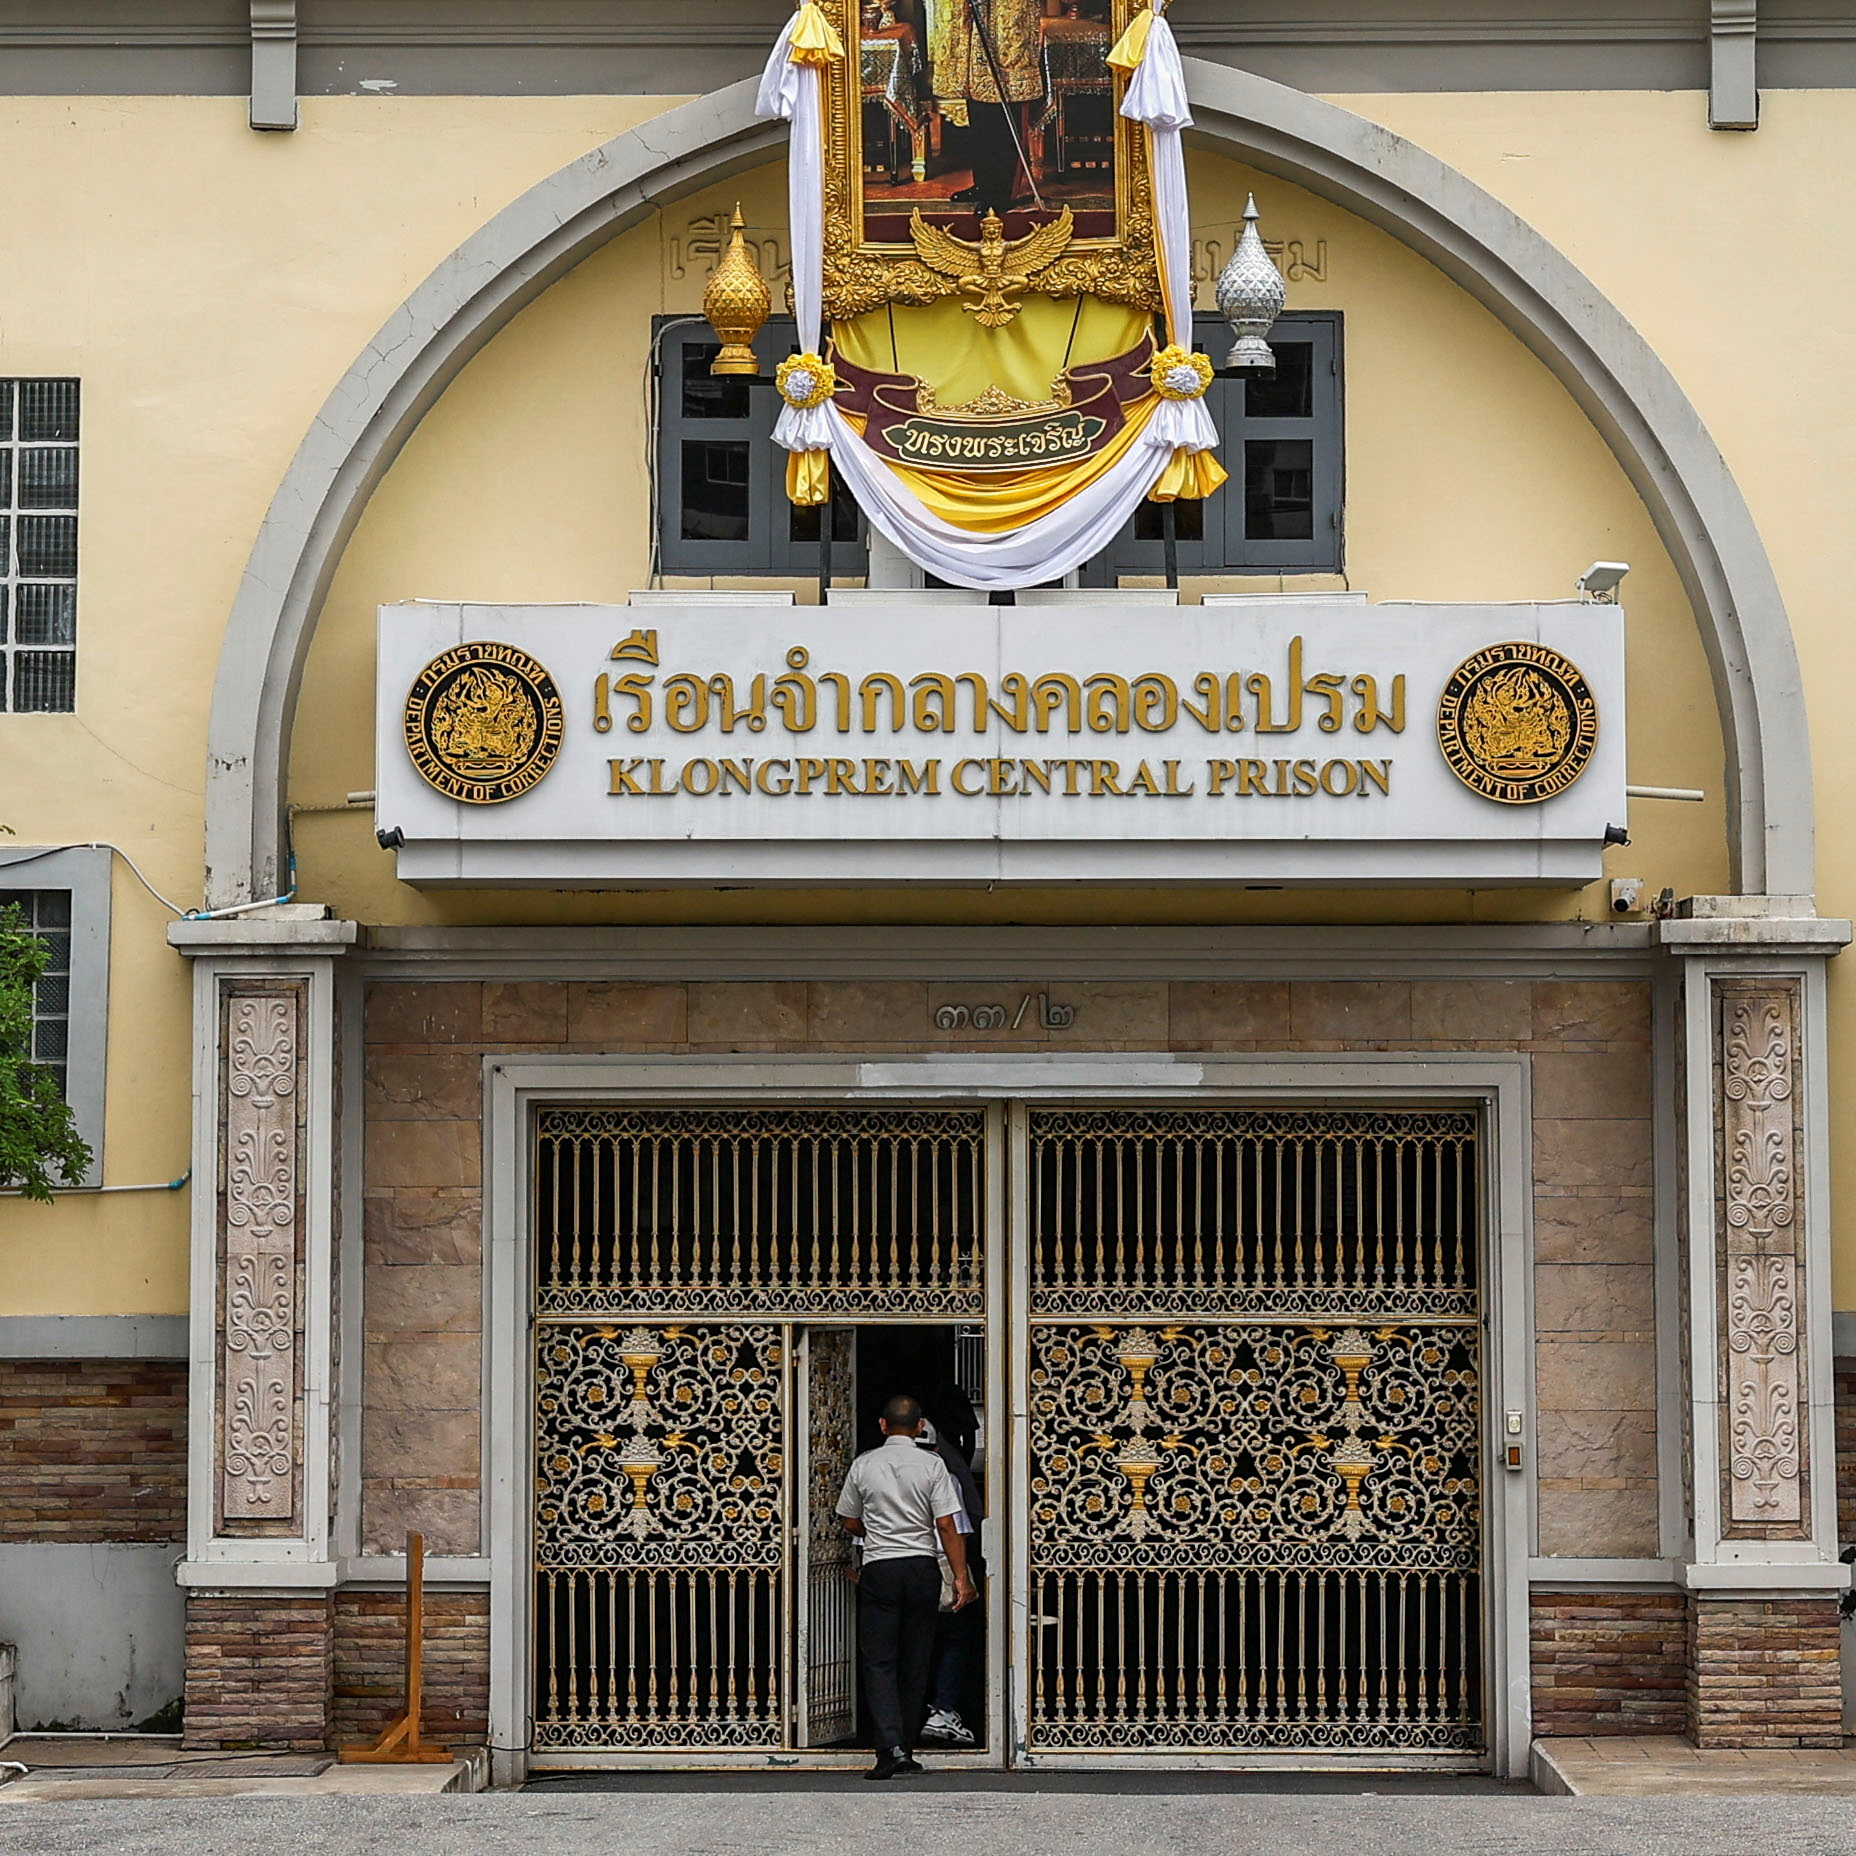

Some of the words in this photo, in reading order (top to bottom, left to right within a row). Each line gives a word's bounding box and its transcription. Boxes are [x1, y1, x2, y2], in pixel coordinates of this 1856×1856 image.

[904, 421, 1085, 458] ทรงพระเจริญ
[592, 629, 1406, 733] เรือนจำกลางคลองเปรม
[406, 699, 472, 800] DEPARTMENT
[473, 785, 497, 800] OF
[501, 697, 563, 796] CORRECTIONS
[607, 758, 942, 796] KLONGPREM
[951, 758, 1195, 796] CENTRAL
[1206, 759, 1393, 796] PRISON
[1440, 695, 1505, 799] DEPARTMENT
[1506, 784, 1530, 800] OF
[1534, 698, 1596, 797] CORRECTIONS
[935, 993, 1076, 1031] ๓๓/๒
